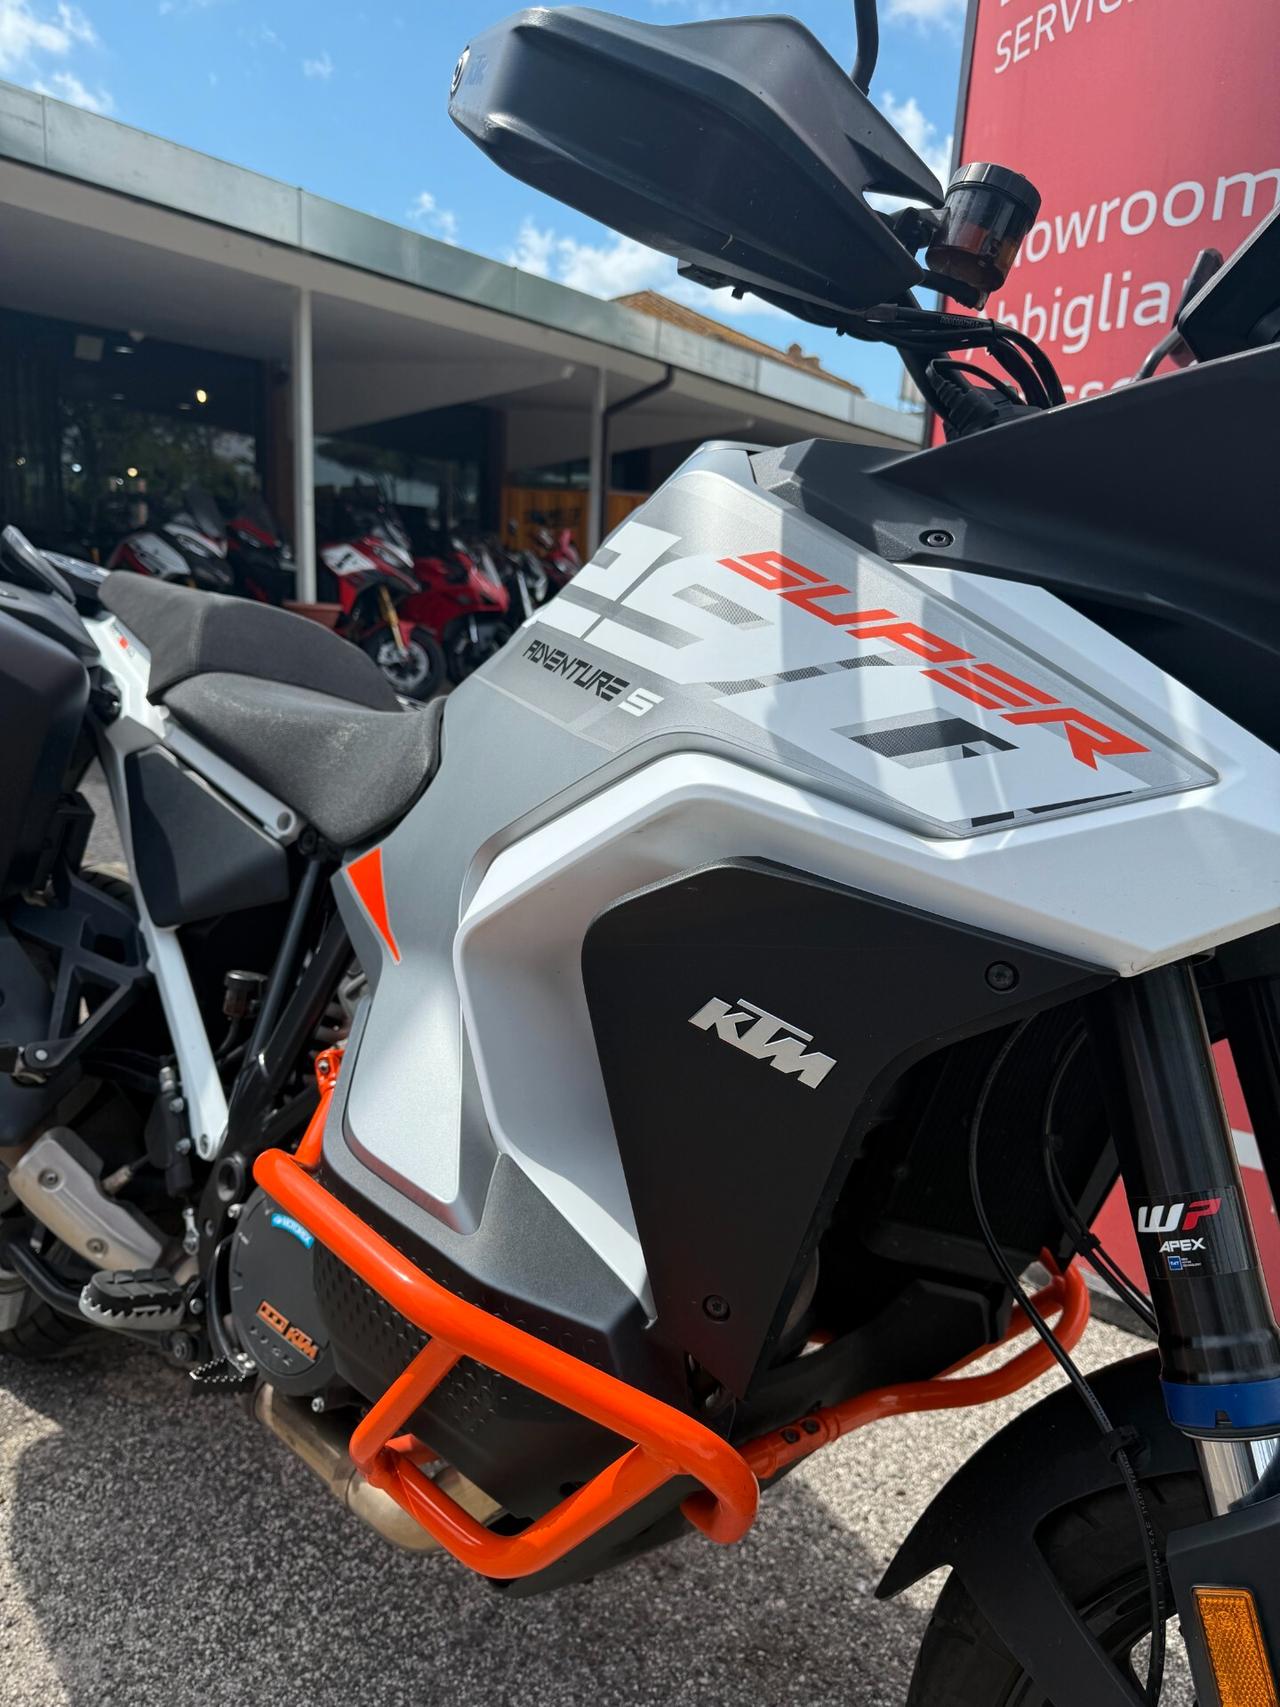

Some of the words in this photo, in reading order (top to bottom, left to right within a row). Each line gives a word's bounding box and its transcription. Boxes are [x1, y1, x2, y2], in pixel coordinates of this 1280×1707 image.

[522, 639, 630, 702] ADVENTURE
[617, 687, 665, 717] S
[716, 550, 1151, 770] SUPER
[688, 997, 838, 1089] KTM
[1138, 1198, 1222, 1233] WP
[1159, 1237, 1206, 1253] APEX
